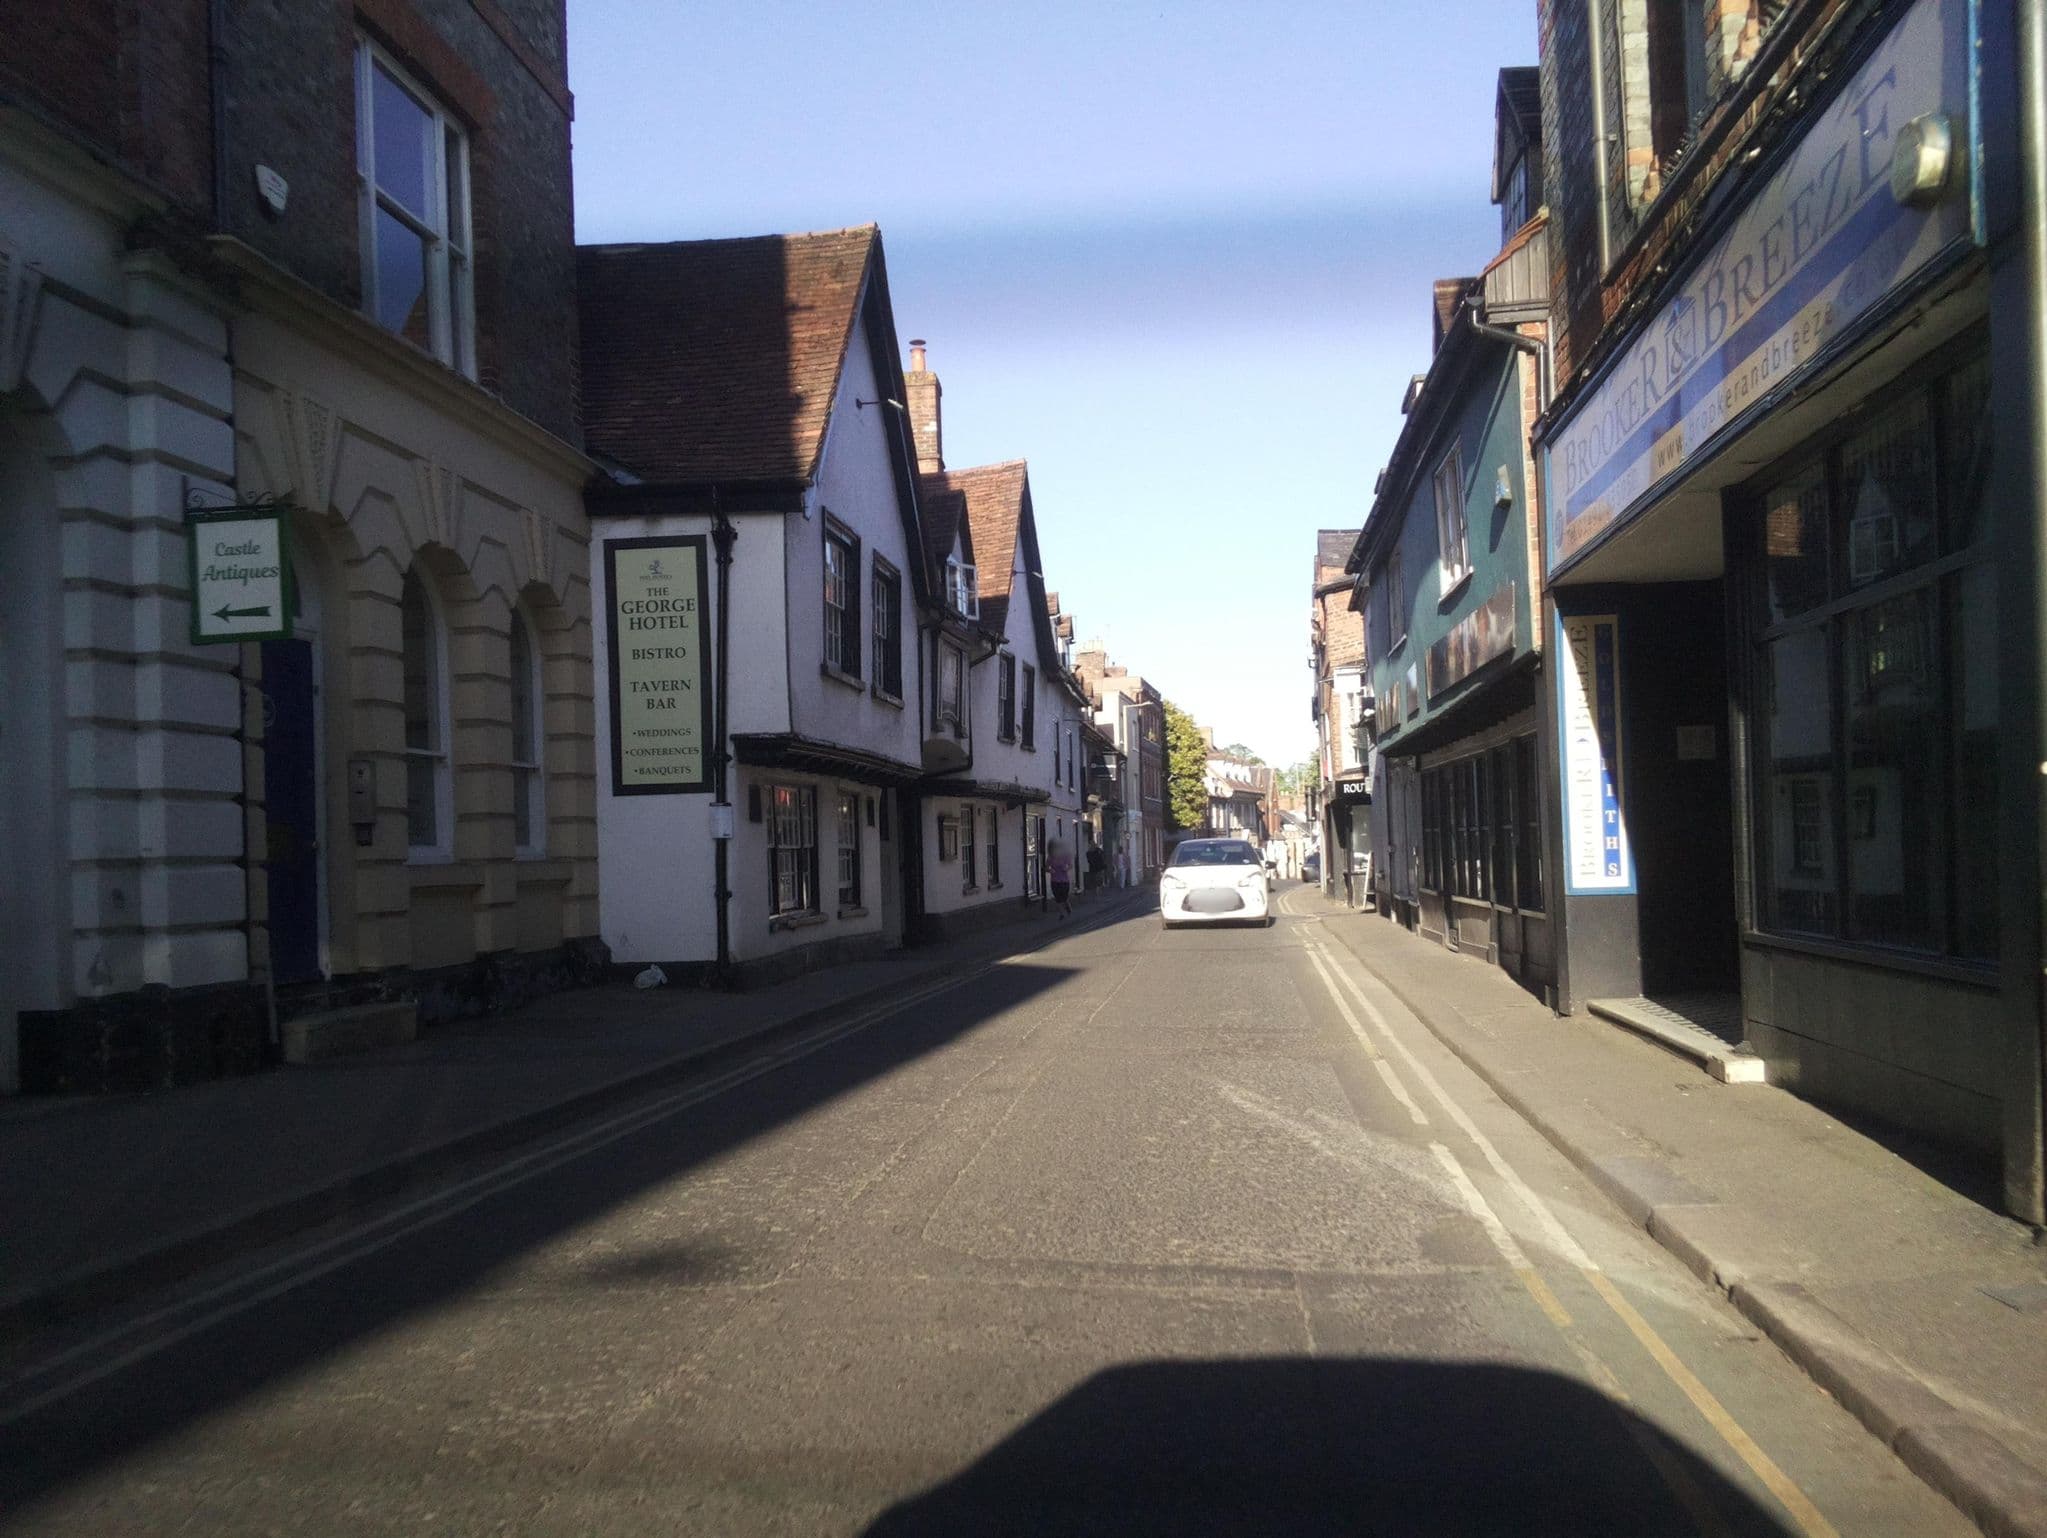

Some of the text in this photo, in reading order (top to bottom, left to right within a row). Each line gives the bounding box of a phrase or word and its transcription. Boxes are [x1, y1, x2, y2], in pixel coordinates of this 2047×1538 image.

[1565, 344, 1665, 493] BROOKER
[214, 539, 261, 557] Castle
[201, 564, 280, 587] Antiques
[646, 587, 670, 597] THE
[621, 598, 696, 615] GEORGE
[629, 615, 689, 631] HOTEL
[632, 647, 687, 660] BISTRO
[629, 679, 692, 693] TAVERN
[646, 697, 677, 710] BAR
[637, 727, 692, 738] WEDDINGS
[630, 746, 700, 757] CONFERENCES
[639, 766, 692, 776] BANQUETS
